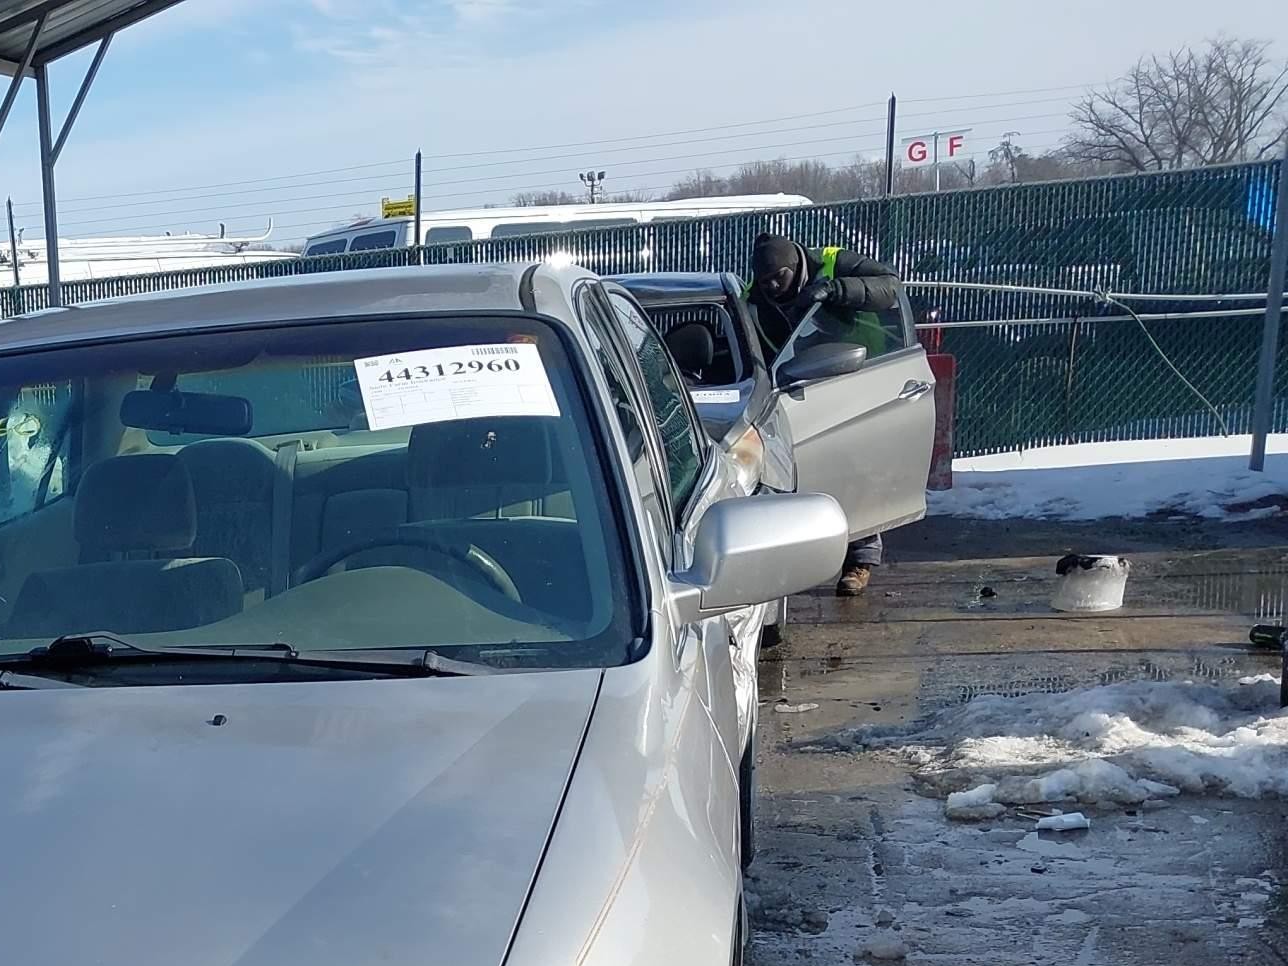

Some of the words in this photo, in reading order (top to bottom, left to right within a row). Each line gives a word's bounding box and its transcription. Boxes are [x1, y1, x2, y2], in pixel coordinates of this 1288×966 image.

[907, 141, 927, 162] G
[949, 135, 964, 157] F
[378, 358, 521, 383] 44312960
